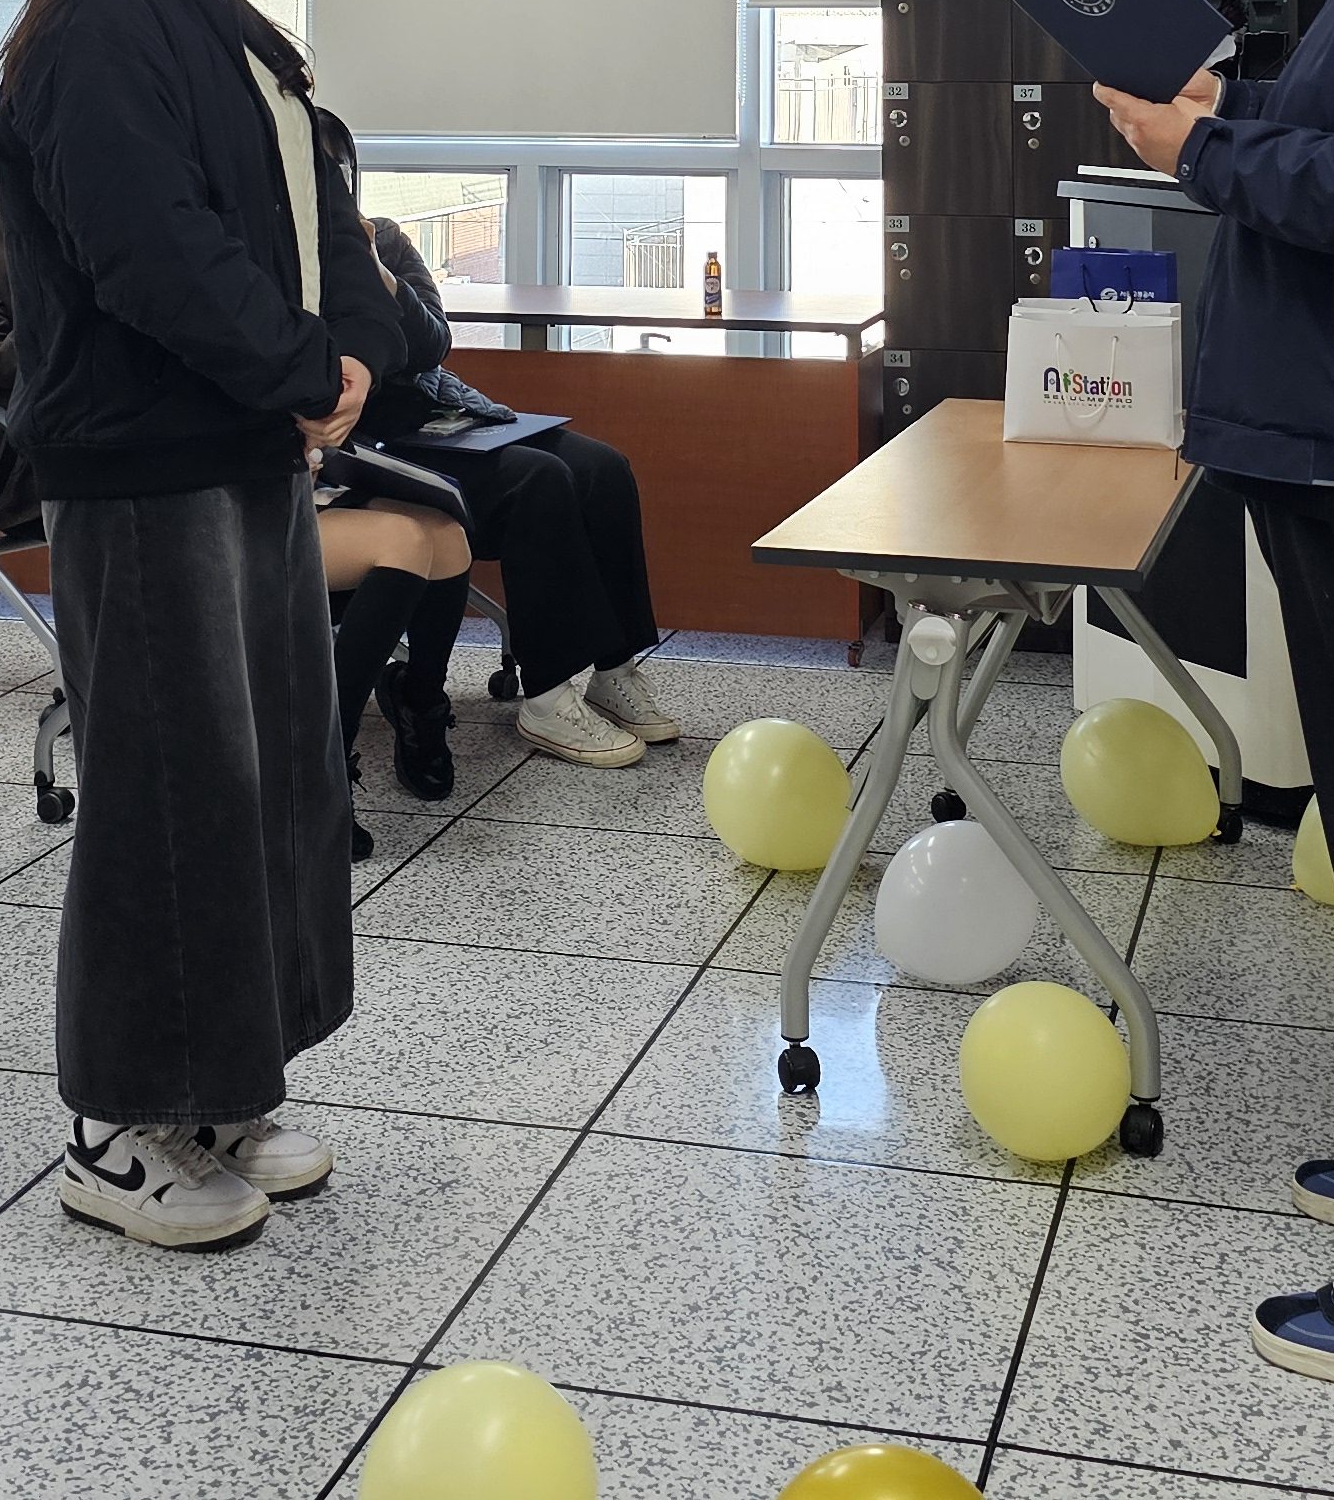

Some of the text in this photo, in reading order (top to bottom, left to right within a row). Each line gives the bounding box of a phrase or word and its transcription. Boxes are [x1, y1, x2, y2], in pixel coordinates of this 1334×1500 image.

[888, 86, 902, 96] 32
[1020, 88, 1034, 98] 37
[888, 219, 903, 229] 33
[1021, 223, 1036, 233] 38
[890, 354, 904, 363] 34
